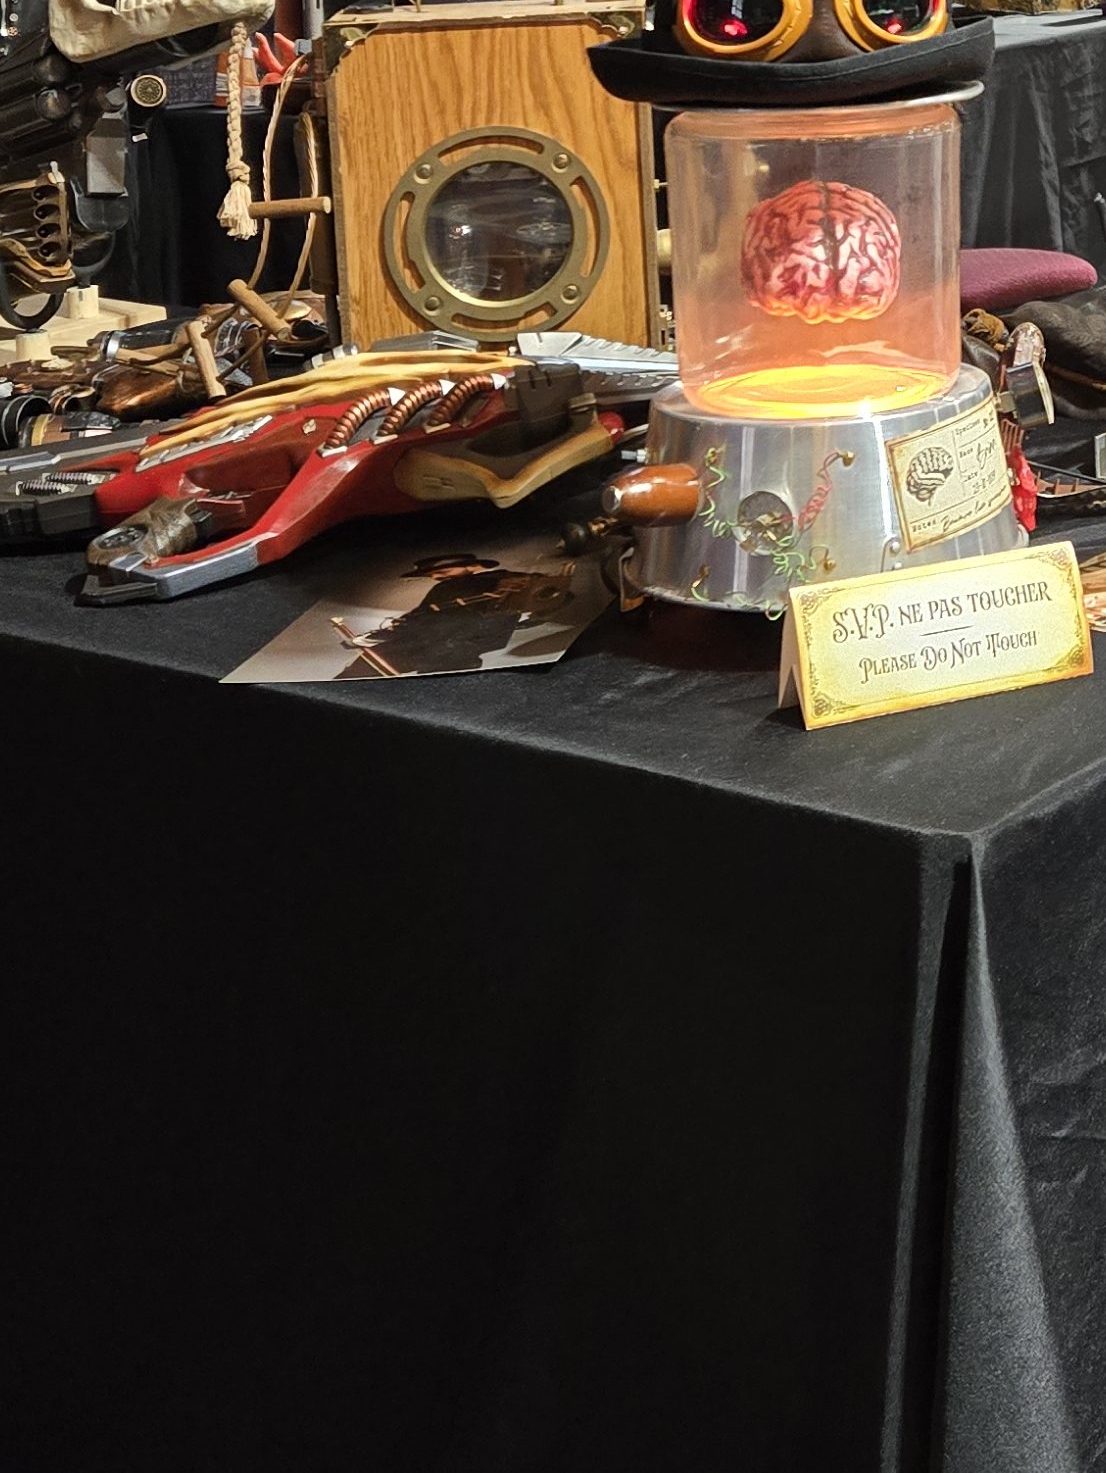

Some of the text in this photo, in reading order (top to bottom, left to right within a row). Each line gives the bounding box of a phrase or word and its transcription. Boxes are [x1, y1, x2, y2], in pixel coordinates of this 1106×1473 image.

[832, 581, 1052, 644] S.V.P. NE PAS TOUCHER
